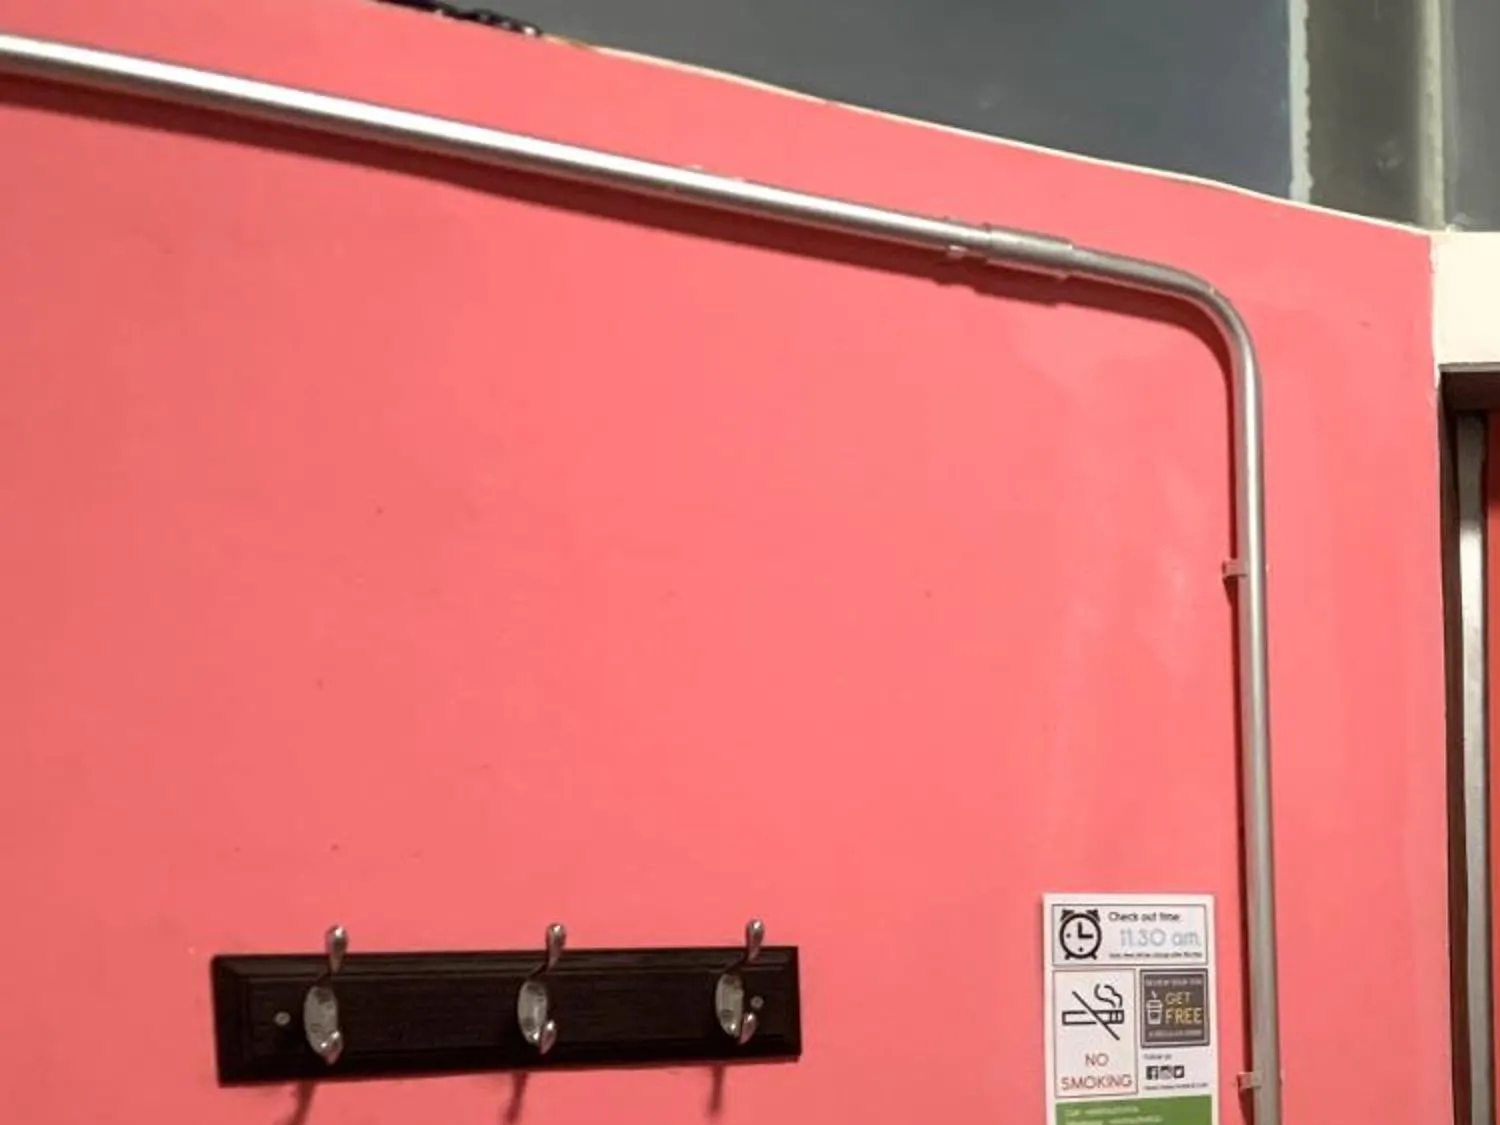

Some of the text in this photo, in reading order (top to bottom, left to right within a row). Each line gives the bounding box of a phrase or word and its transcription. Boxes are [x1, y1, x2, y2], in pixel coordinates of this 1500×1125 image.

[1108, 911, 1138, 922] Check
[1165, 991, 1192, 1005] GET
[1165, 1007, 1202, 1025] FREE
[1085, 1053, 1110, 1067] NO
[1061, 1073, 1133, 1091] SMOKING
